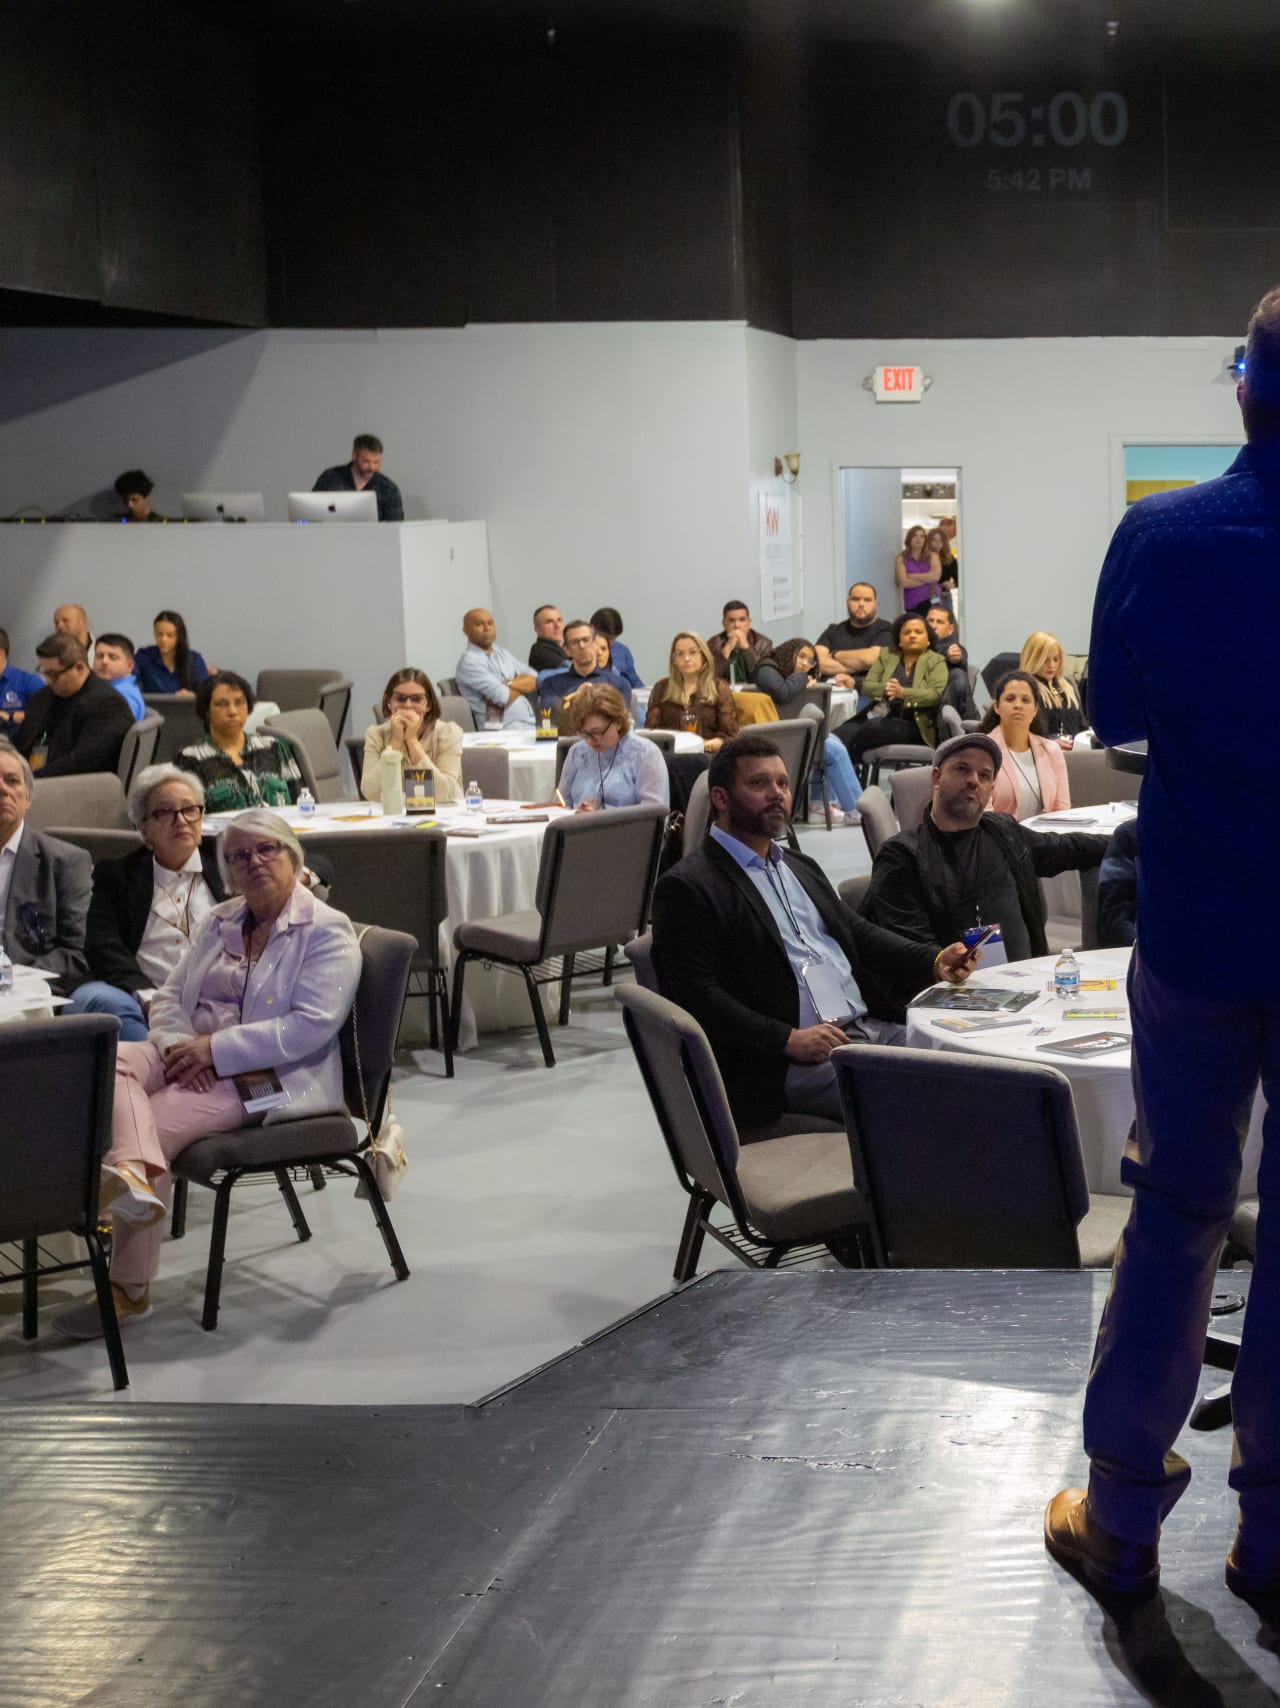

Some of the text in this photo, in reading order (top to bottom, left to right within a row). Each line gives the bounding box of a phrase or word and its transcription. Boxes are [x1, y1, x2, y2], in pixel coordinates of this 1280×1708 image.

[947, 90, 1129, 148] 05:00
[986, 168, 1092, 192] 5:42 PM
[883, 367, 914, 392] EXIT
